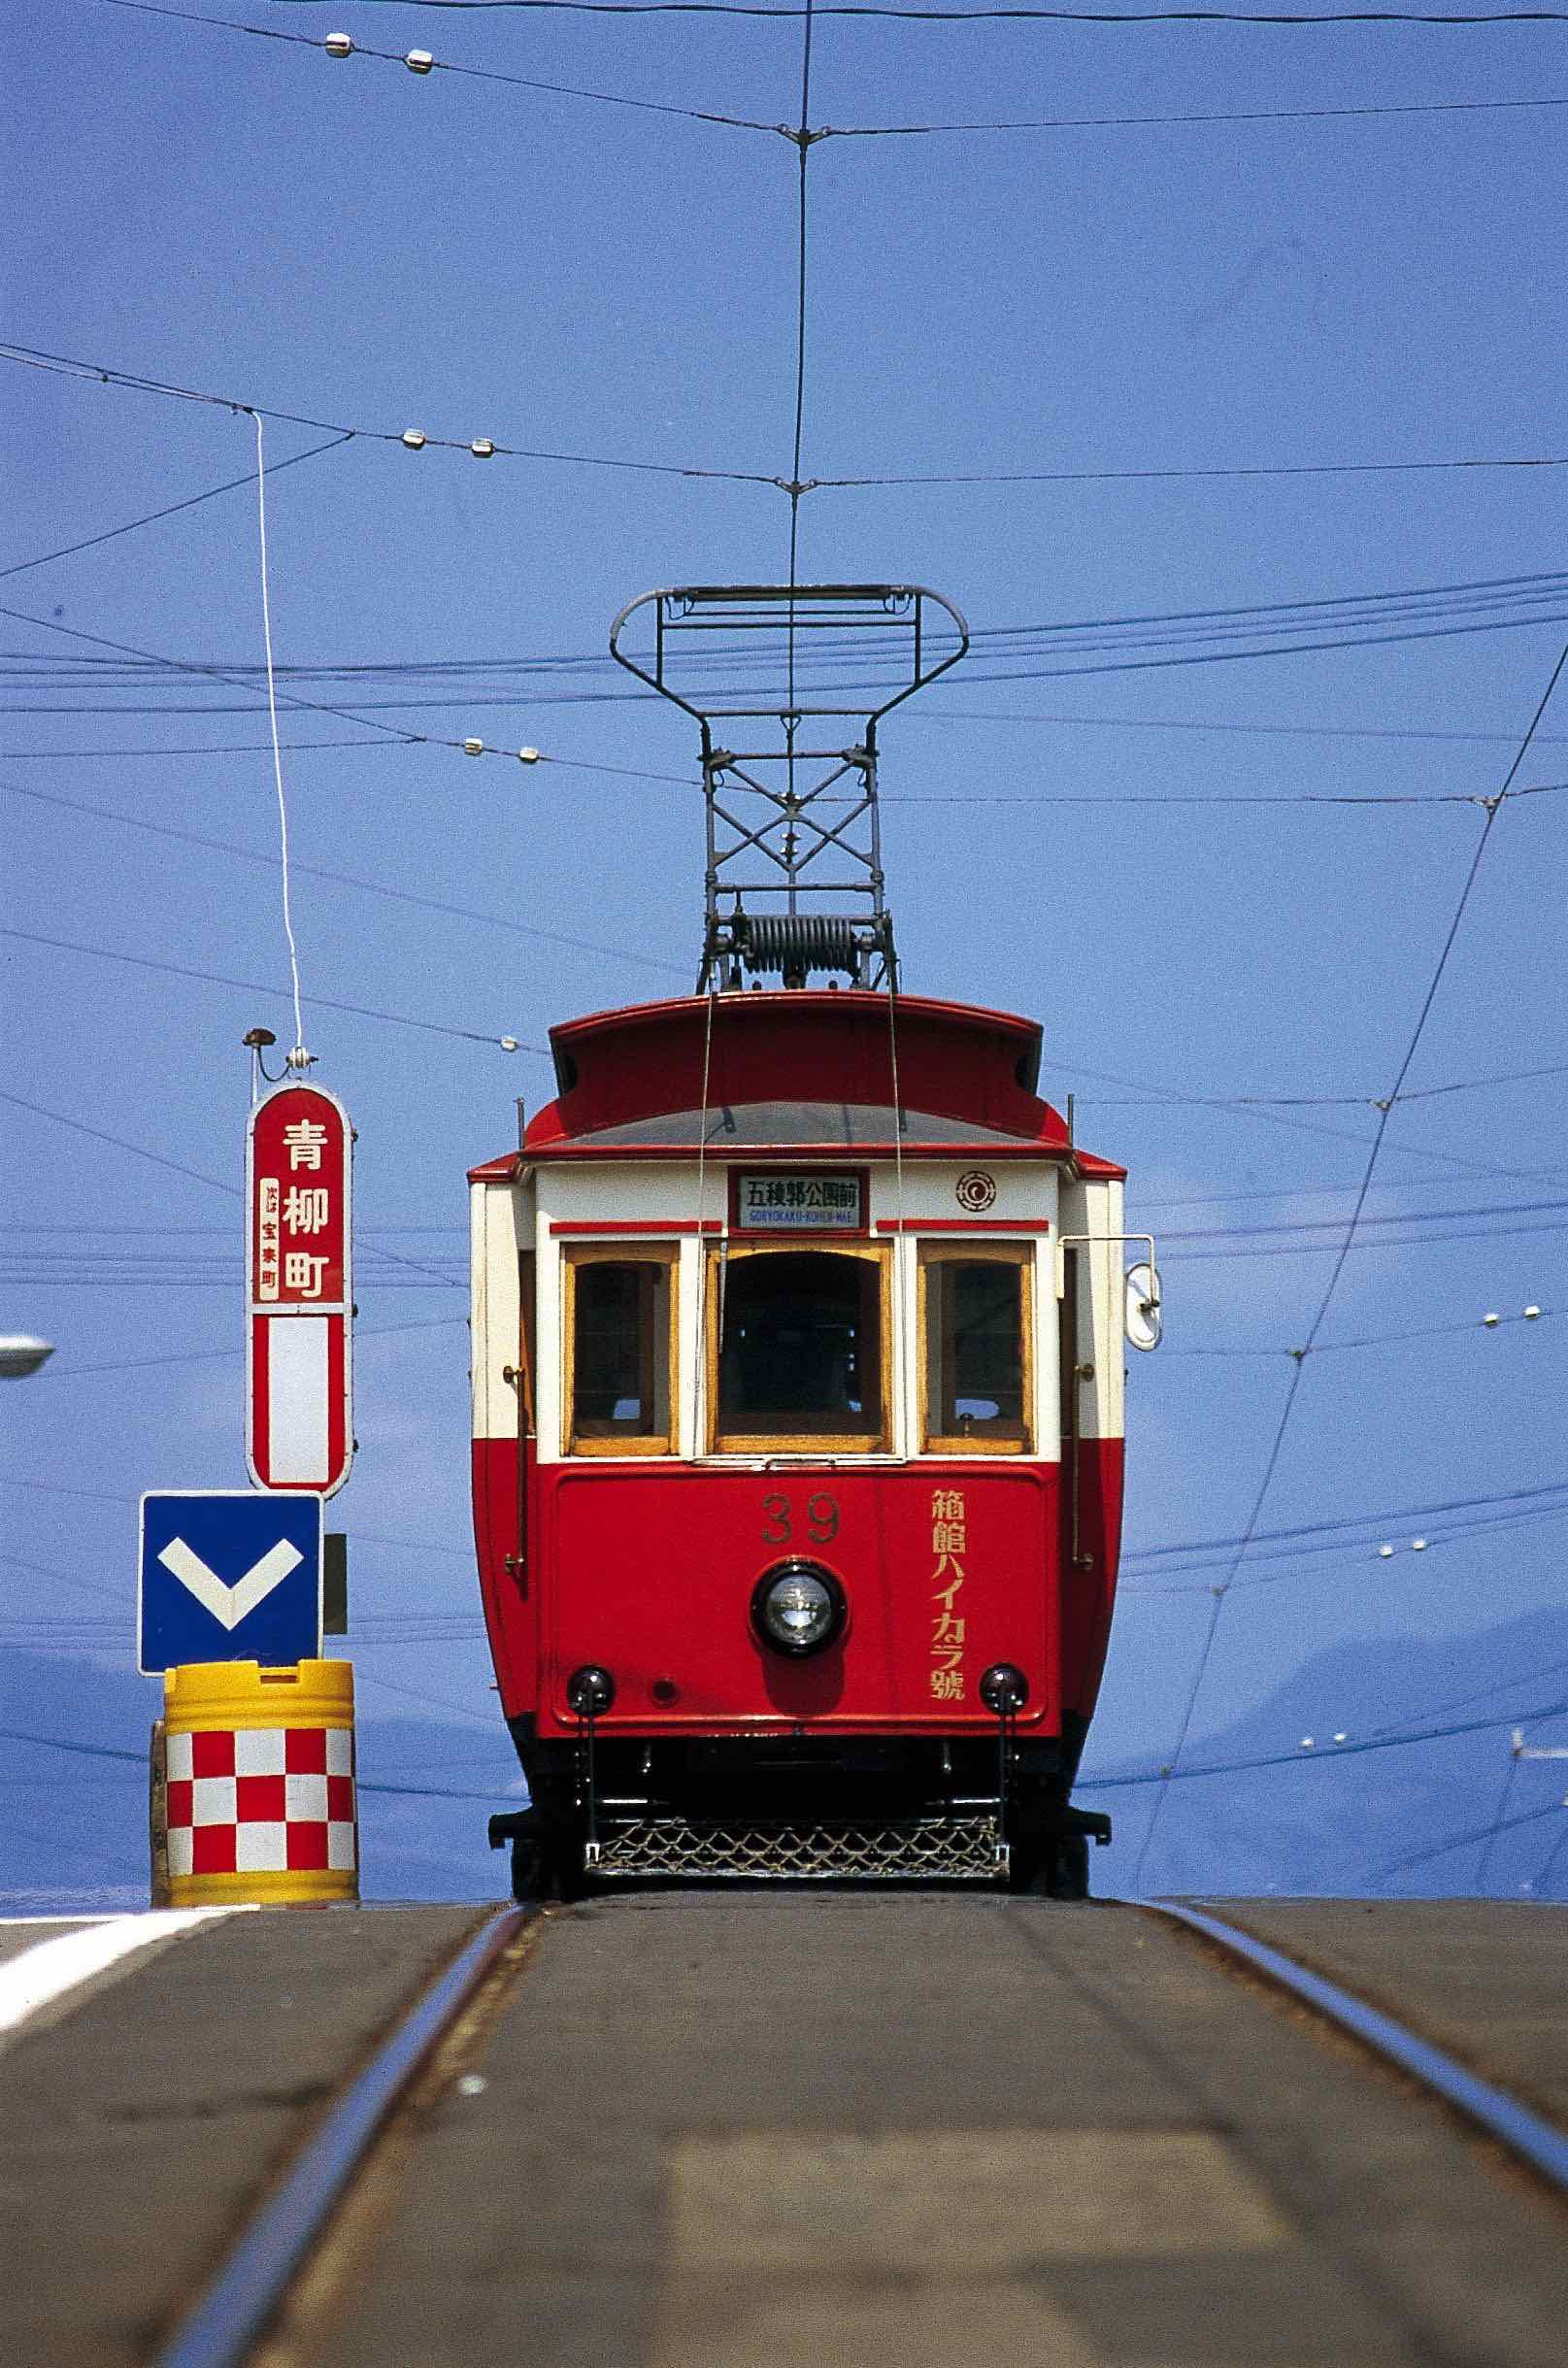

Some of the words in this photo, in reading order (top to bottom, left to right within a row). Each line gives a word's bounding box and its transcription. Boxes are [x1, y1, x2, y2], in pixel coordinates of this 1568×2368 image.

[283, 1118, 330, 1298] 青柳町
[760, 1491, 840, 1544] 39
